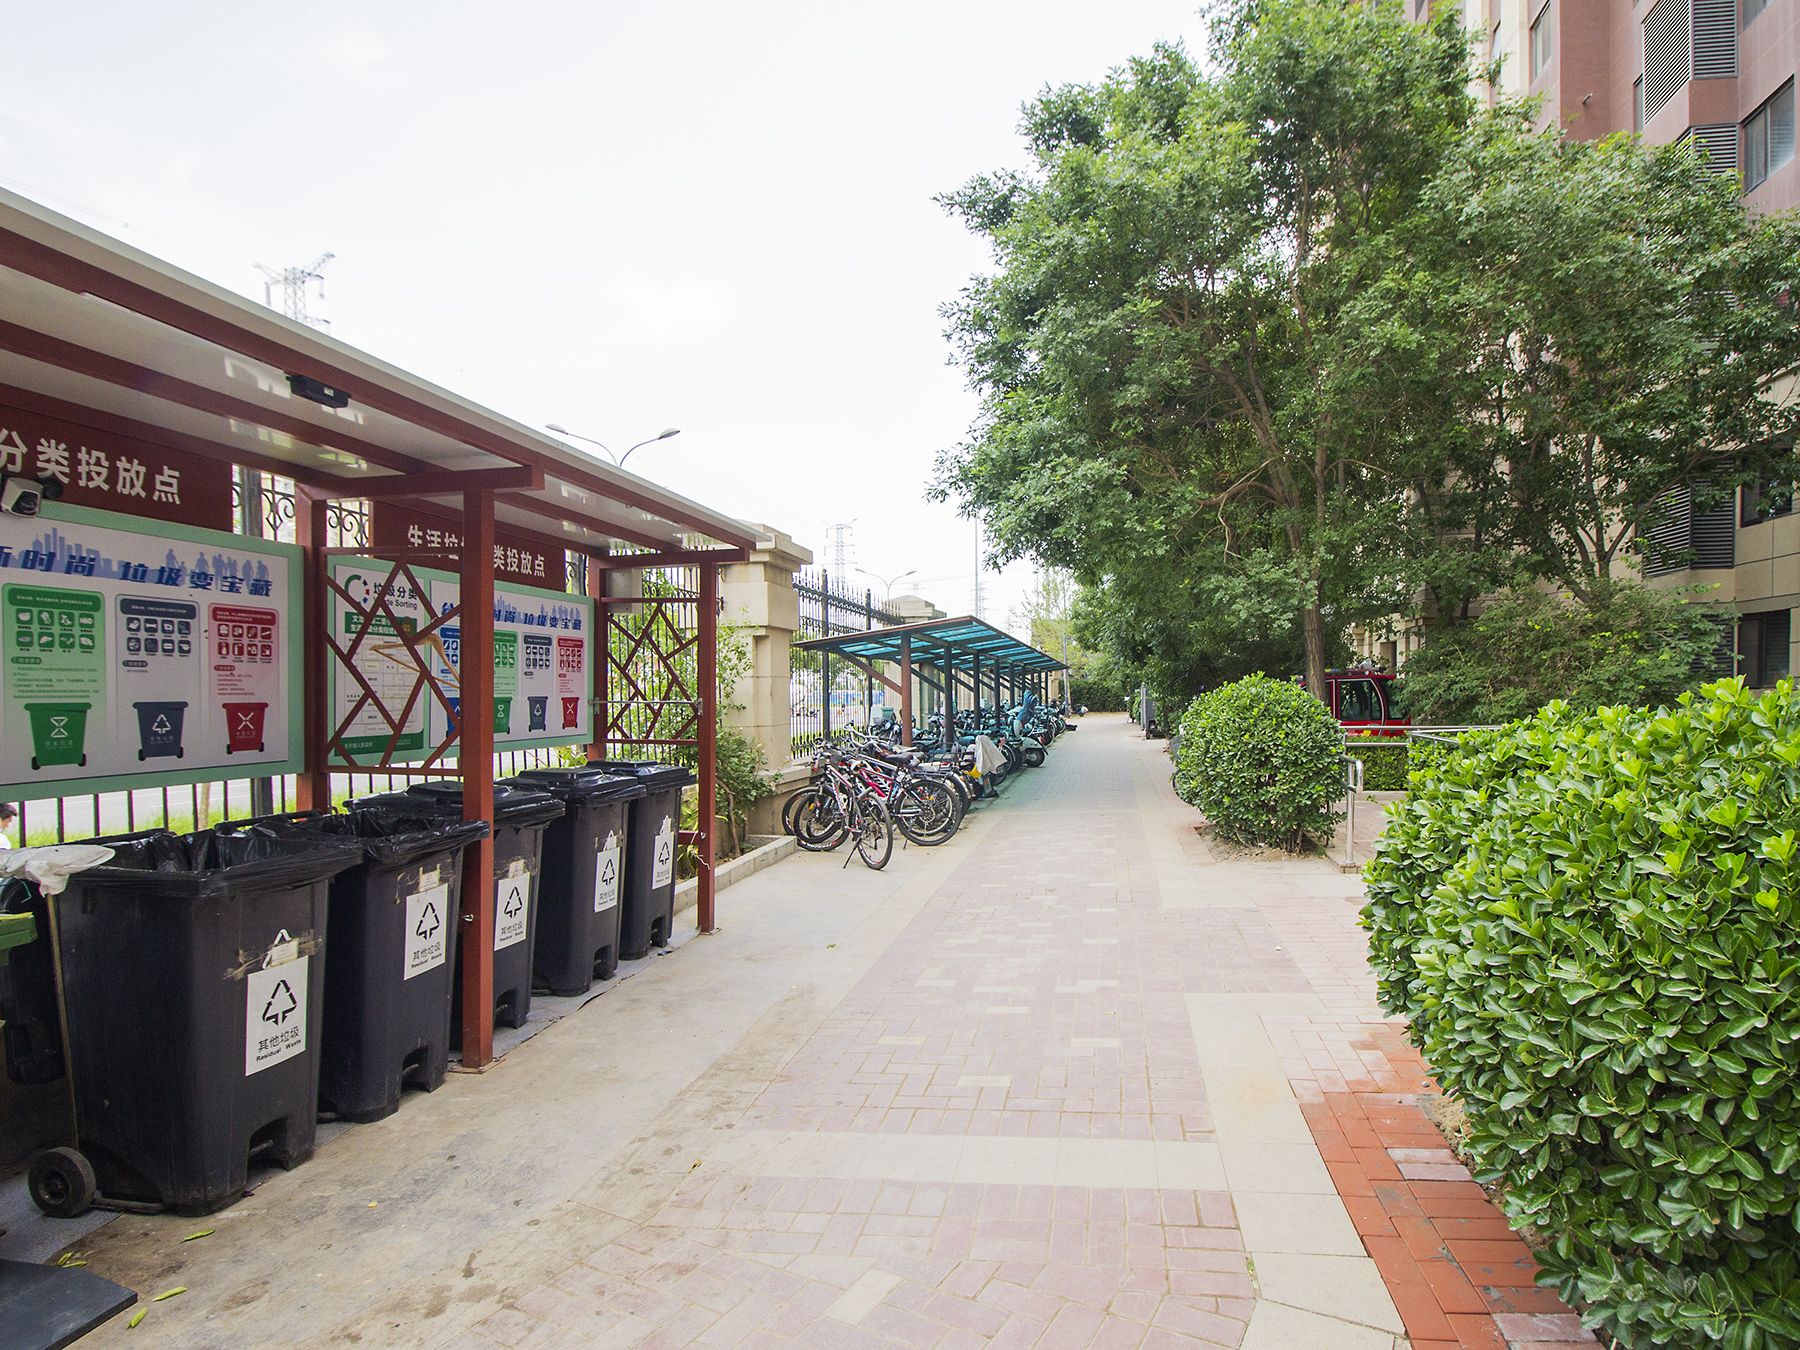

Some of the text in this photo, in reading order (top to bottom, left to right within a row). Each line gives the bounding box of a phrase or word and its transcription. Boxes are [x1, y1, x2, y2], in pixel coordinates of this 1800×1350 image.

[0, 428, 182, 505] 分类投放点
[119, 560, 274, 597] 垃圾变宝藏
[394, 599, 418, 611] Sorting
[255, 1038, 302, 1062] Residual Waste
[257, 1025, 300, 1053] 其他垃圾
